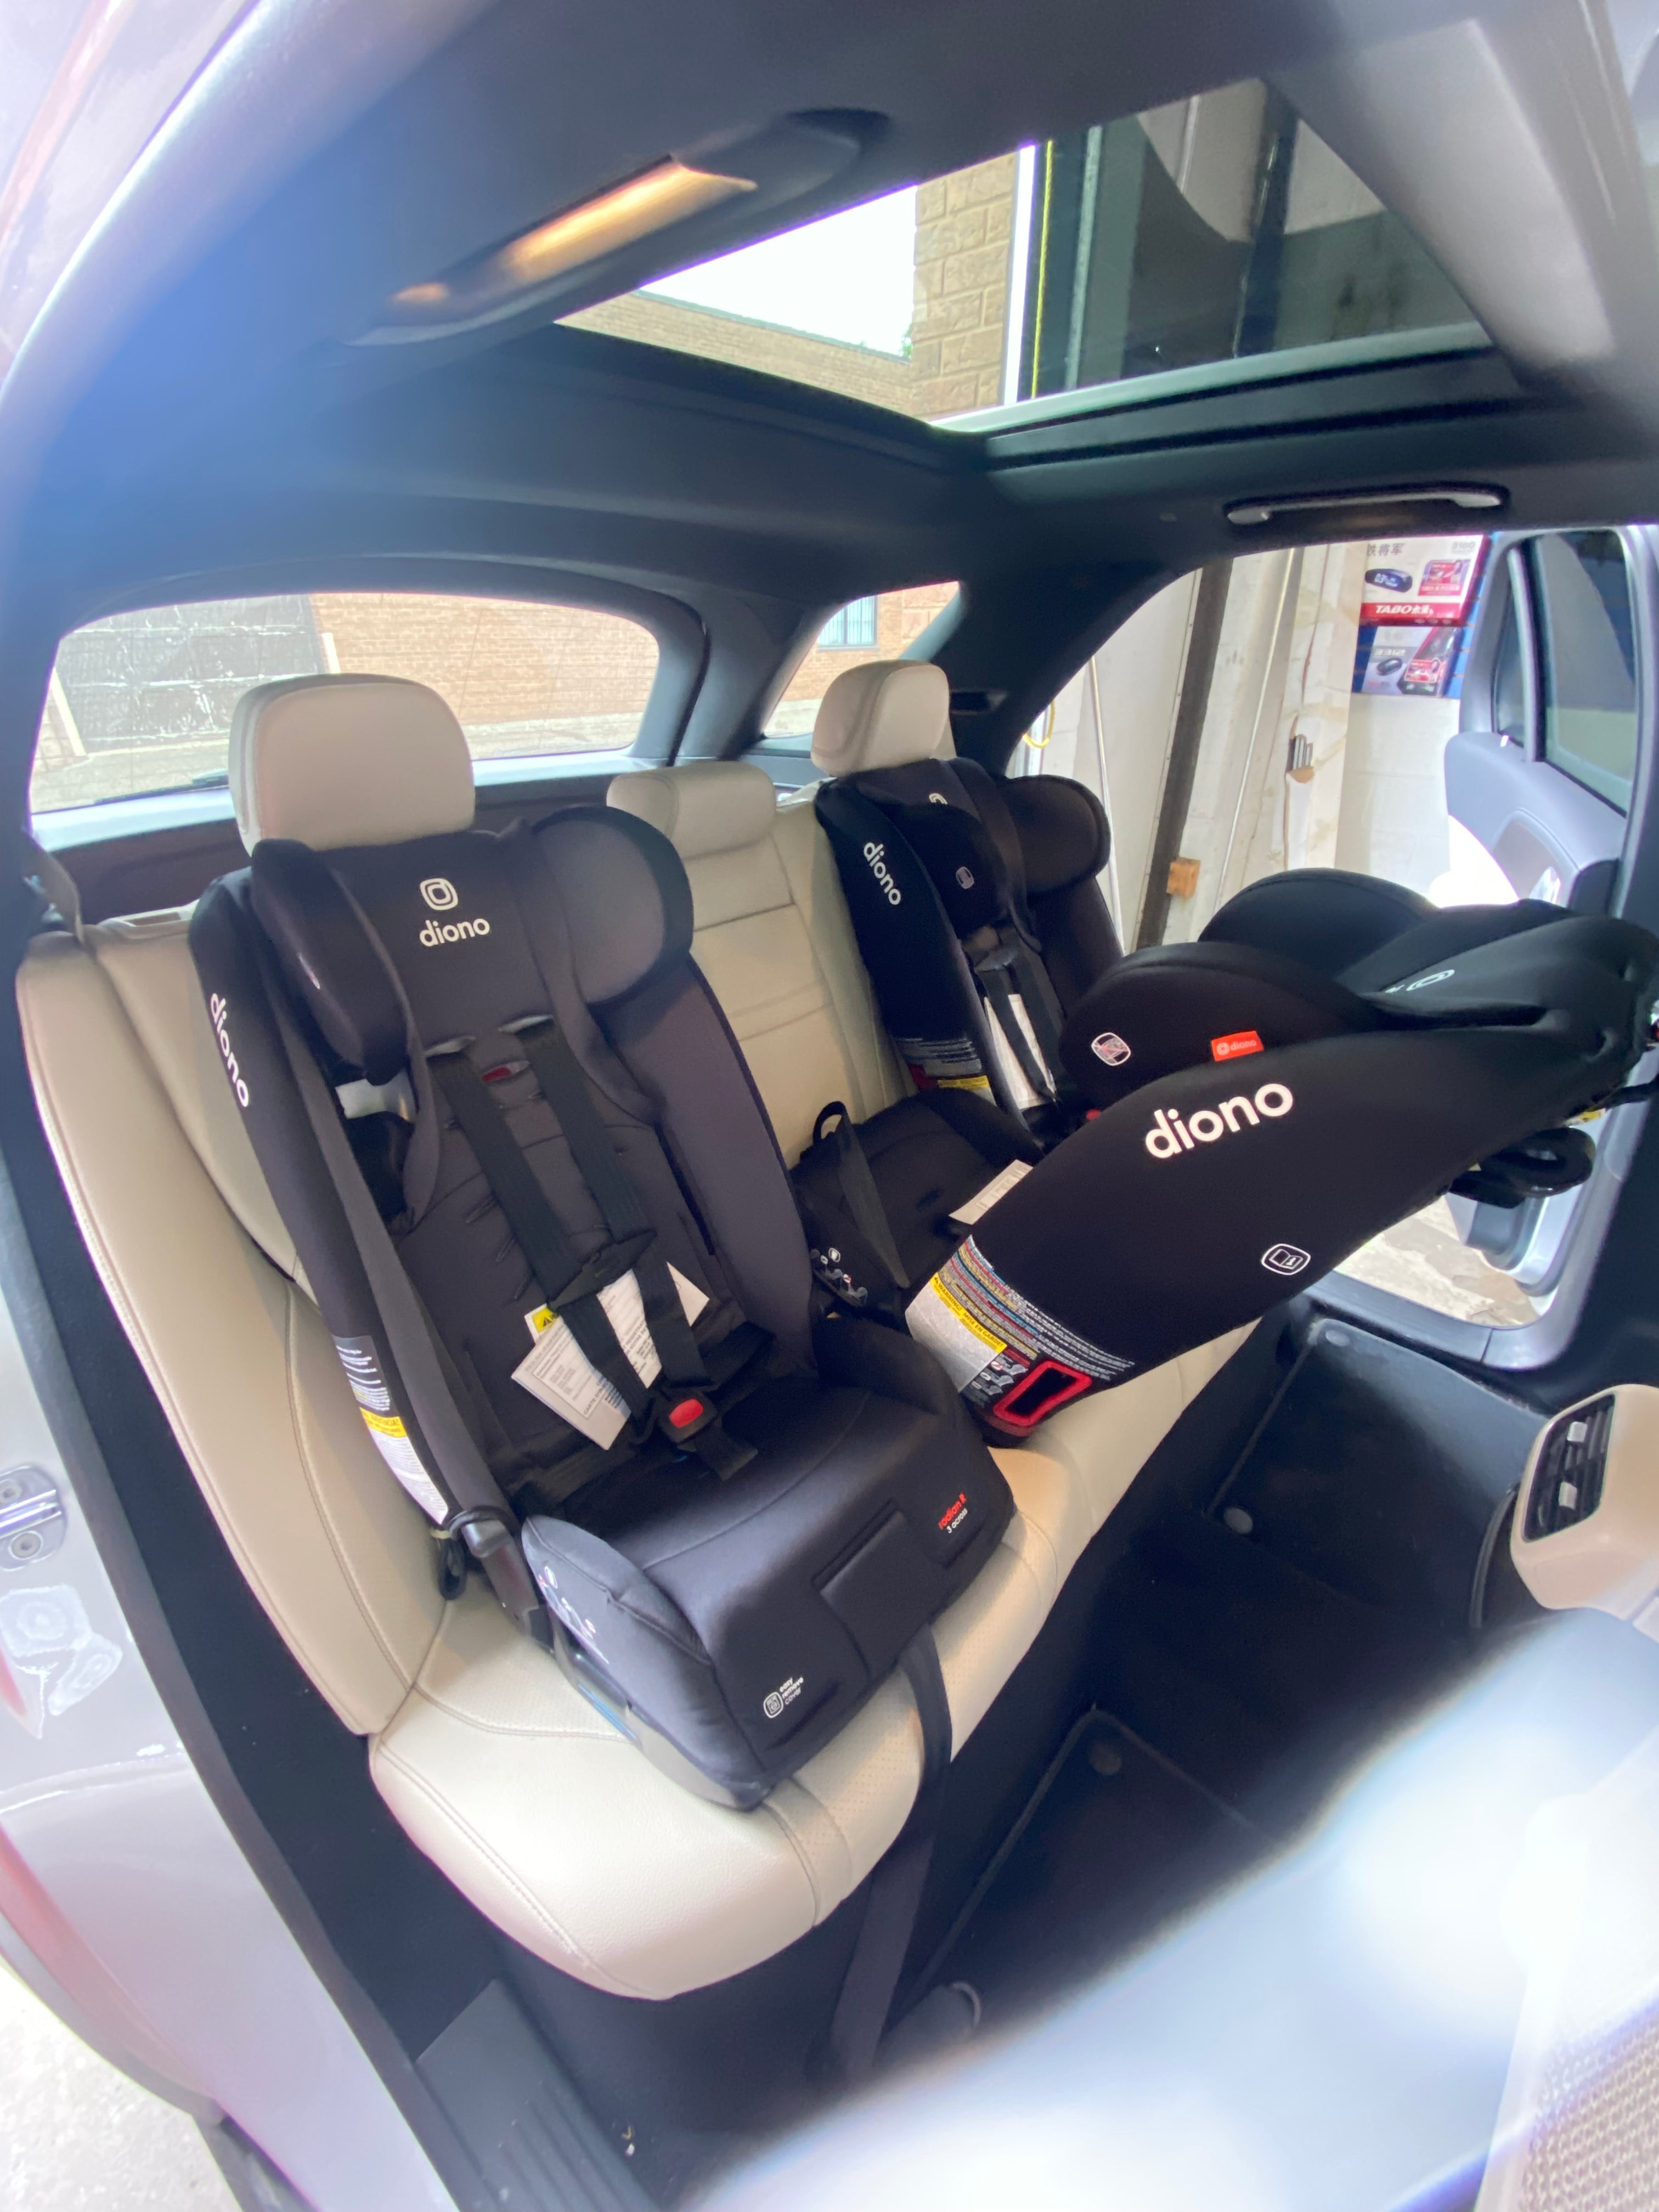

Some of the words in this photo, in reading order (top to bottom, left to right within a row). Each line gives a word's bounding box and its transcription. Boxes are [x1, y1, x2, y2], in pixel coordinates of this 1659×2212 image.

[864, 842, 901, 905] diono
[420, 918, 490, 947] diono
[210, 993, 250, 1108] diono
[1230, 1040, 1257, 1051] diono
[1145, 1083, 1294, 1159] diono
[963, 1312, 975, 1325] MISE
[946, 1525, 952, 1534] 3
[951, 1508, 968, 1529] across
[782, 1677, 804, 1699] remove
